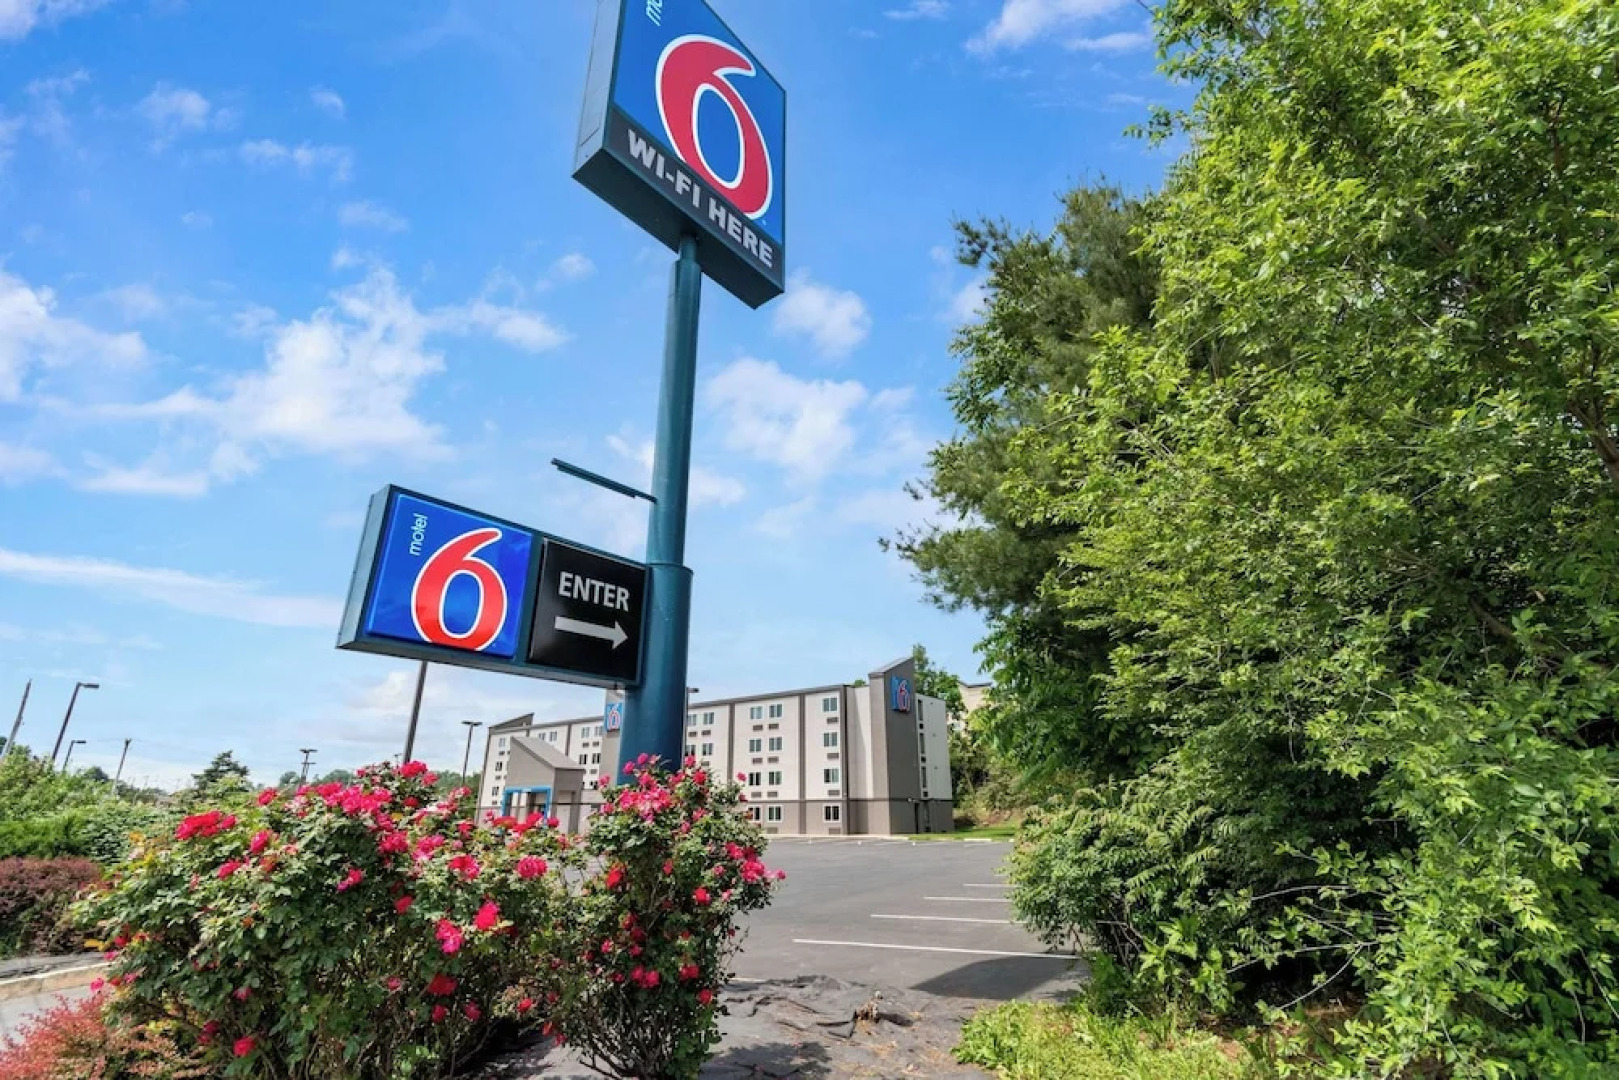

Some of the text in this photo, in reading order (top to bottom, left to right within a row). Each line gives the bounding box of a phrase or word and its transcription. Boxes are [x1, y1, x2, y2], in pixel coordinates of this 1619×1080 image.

[655, 33, 773, 220] 6
[628, 129, 773, 268] WI-FI HERE
[409, 513, 428, 556] motel
[411, 527, 508, 652] 6
[558, 571, 631, 612] ENTER
